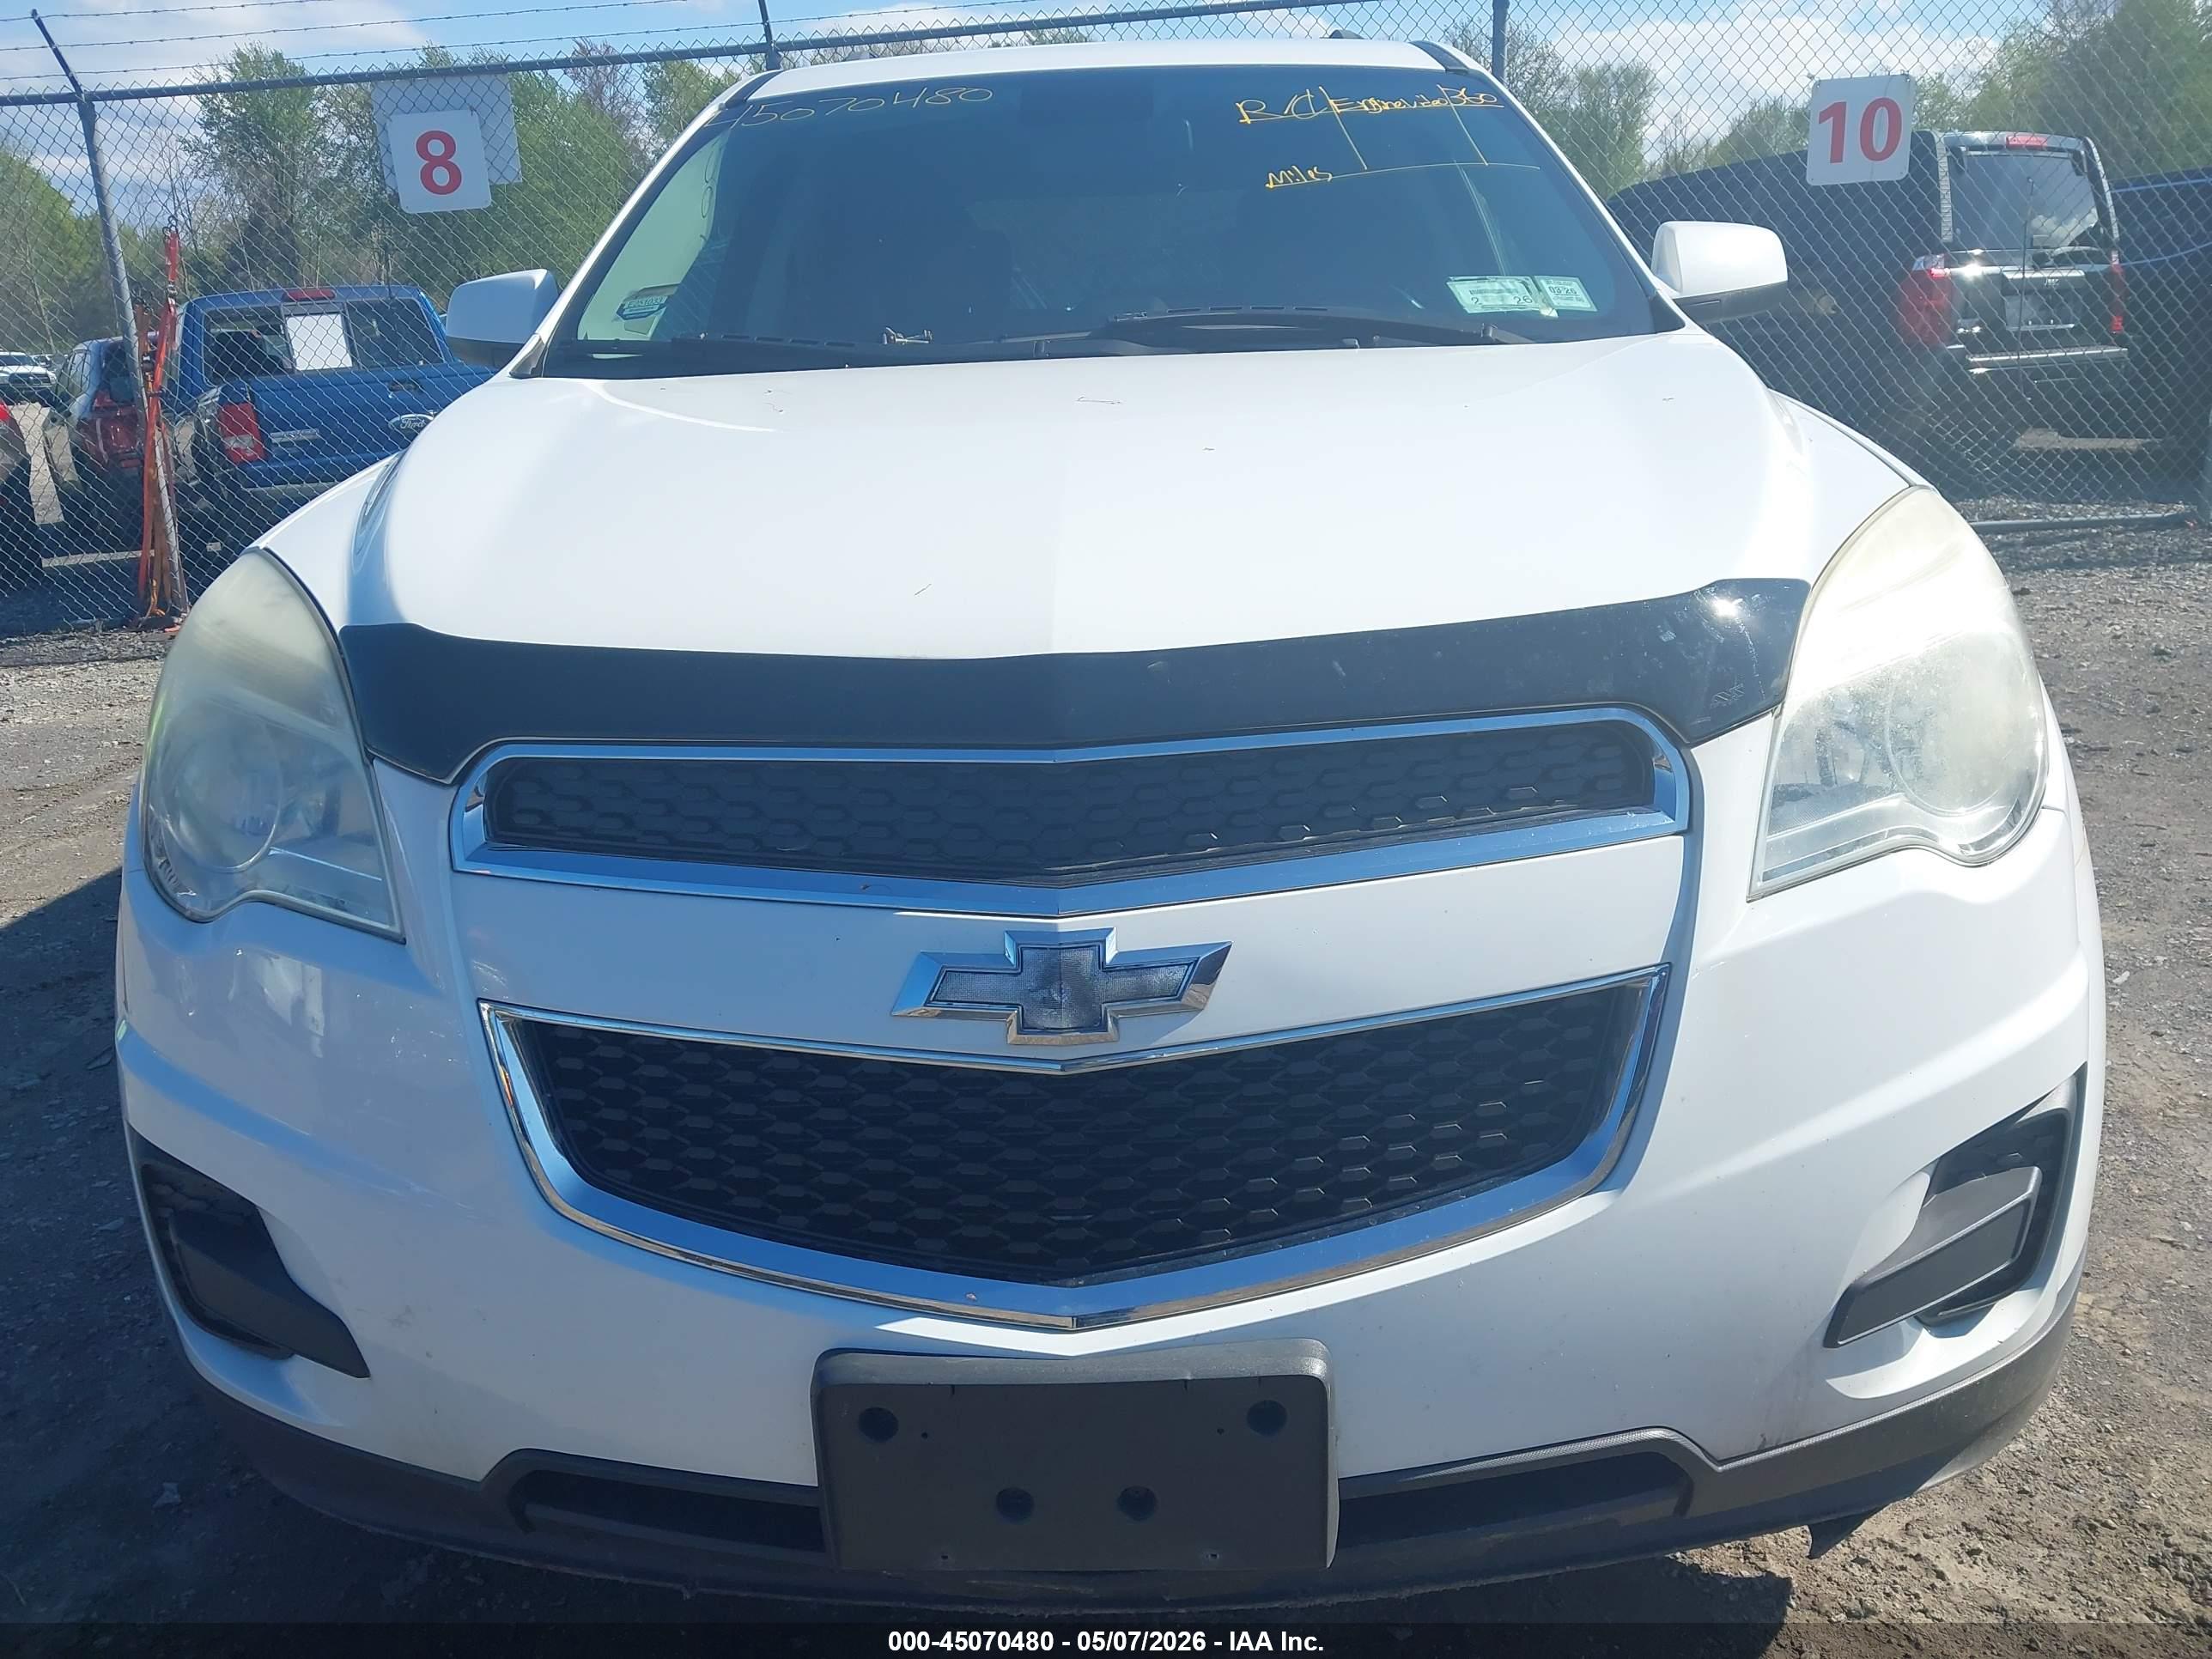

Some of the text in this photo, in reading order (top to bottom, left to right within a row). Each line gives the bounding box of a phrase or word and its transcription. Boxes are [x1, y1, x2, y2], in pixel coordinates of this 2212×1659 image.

[703, 87, 993, 129] 45070480
[1818, 96, 1903, 163] 10
[416, 130, 462, 195] 8
[1267, 165, 1333, 188] Miles
